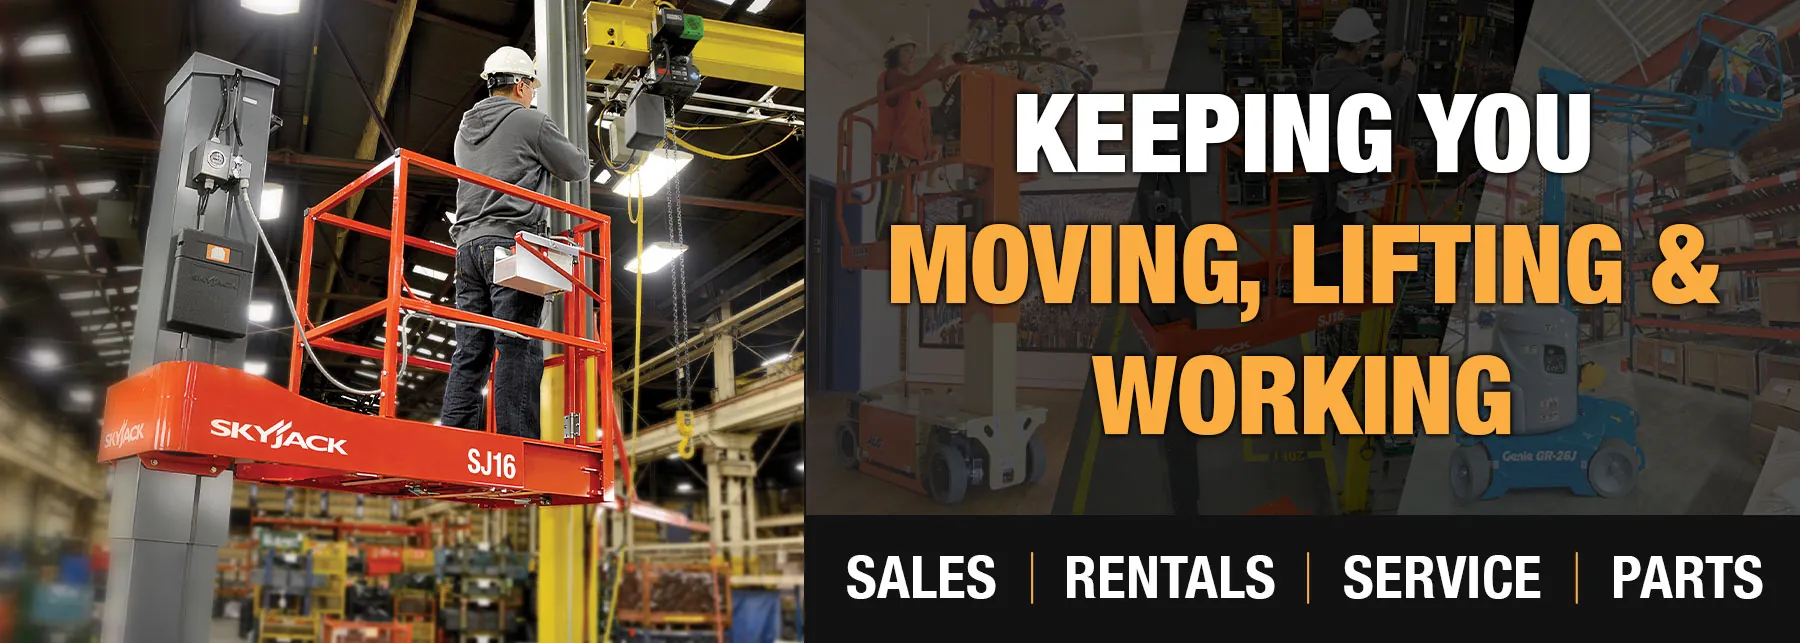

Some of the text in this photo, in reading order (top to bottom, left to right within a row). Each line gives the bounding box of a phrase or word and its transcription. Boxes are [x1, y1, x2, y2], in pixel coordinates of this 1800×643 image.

[104, 419, 144, 449] SKYJACK
[210, 418, 349, 456] SKYJACK
[467, 448, 517, 479] SJ16
[1502, 450, 1533, 461] Genie
